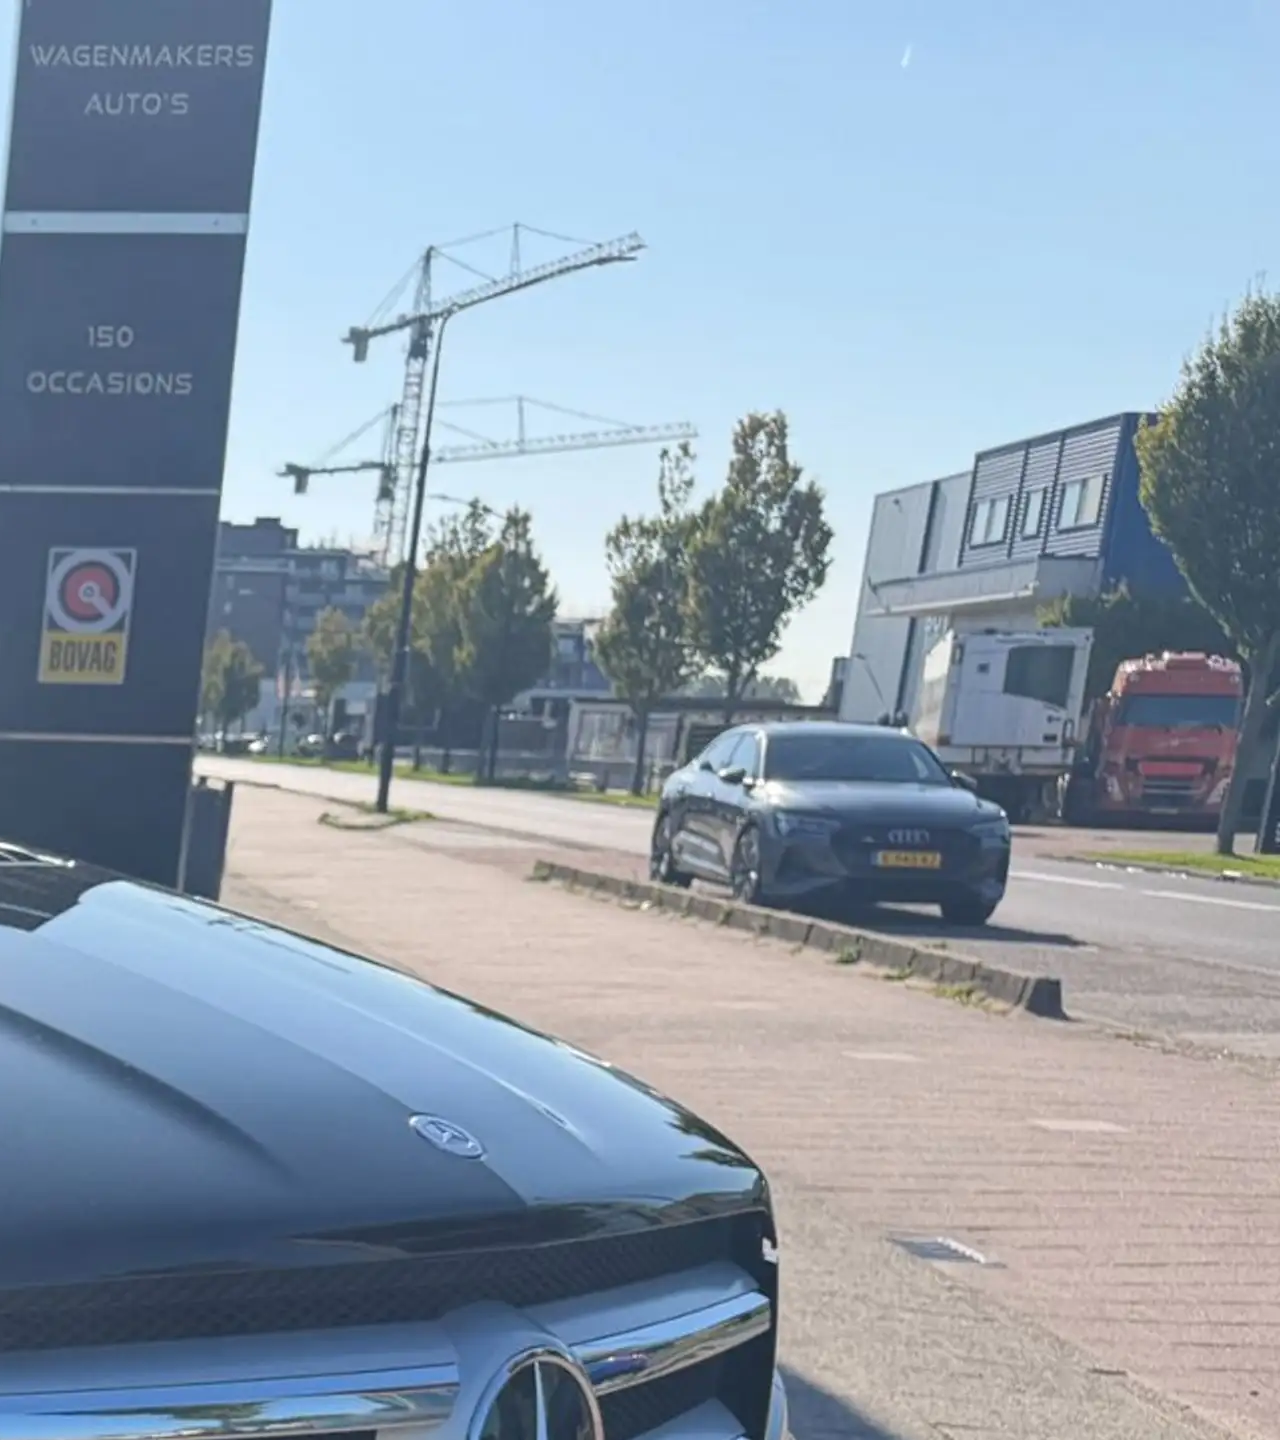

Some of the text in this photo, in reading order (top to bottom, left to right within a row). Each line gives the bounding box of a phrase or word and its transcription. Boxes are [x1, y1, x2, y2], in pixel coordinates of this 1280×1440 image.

[30, 44, 255, 67] WAGENMAKERS
[83, 92, 190, 116] AUTO'S
[87, 325, 135, 349] 150
[26, 371, 193, 395] OCCASIONS
[48, 639, 118, 673] BOVAG
